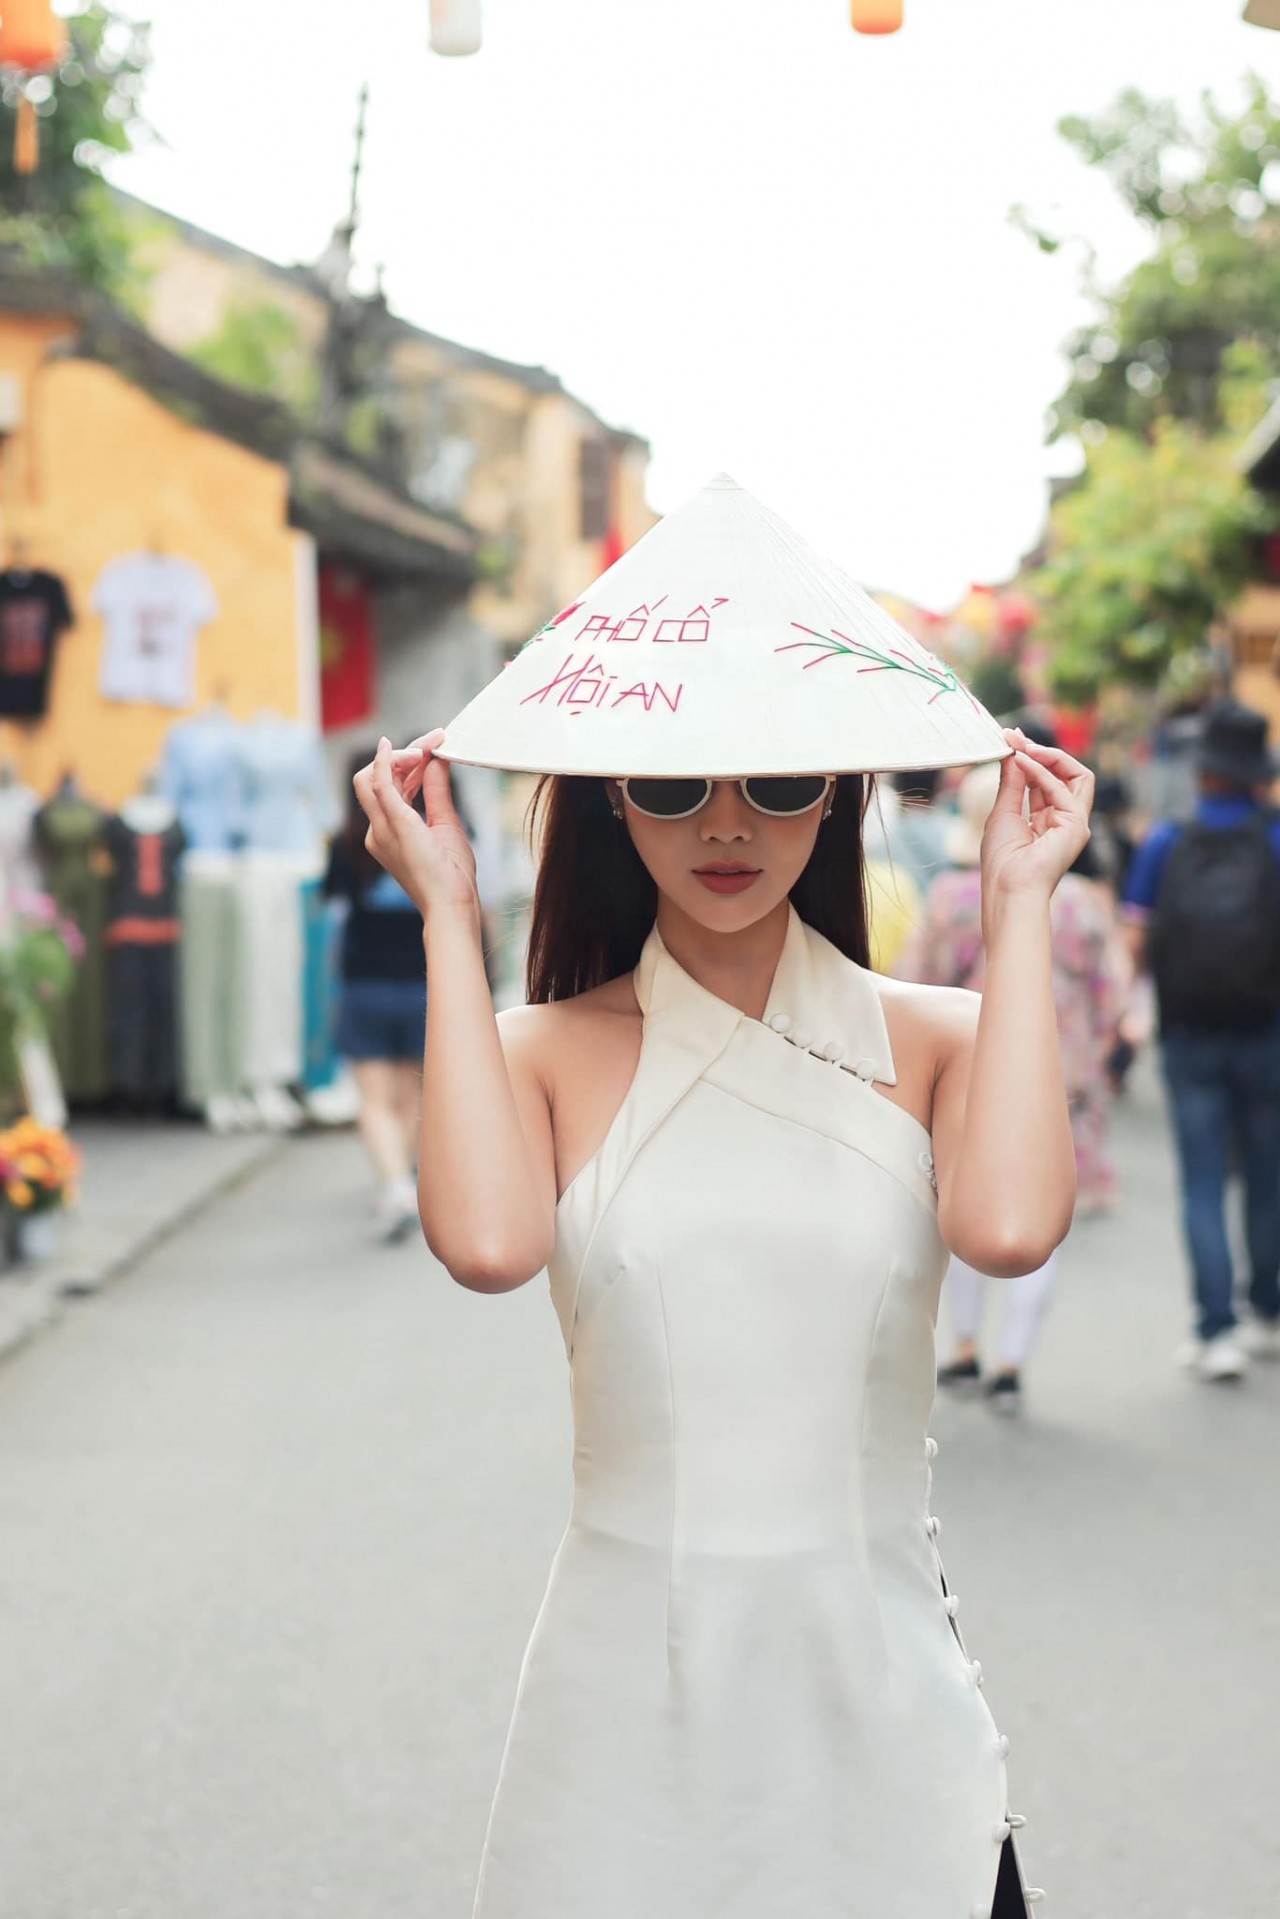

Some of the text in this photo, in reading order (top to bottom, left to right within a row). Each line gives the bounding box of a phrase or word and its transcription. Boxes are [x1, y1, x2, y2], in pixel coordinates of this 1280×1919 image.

[574, 594, 730, 642] PHỐ CỔ
[610, 681, 683, 712] AN
